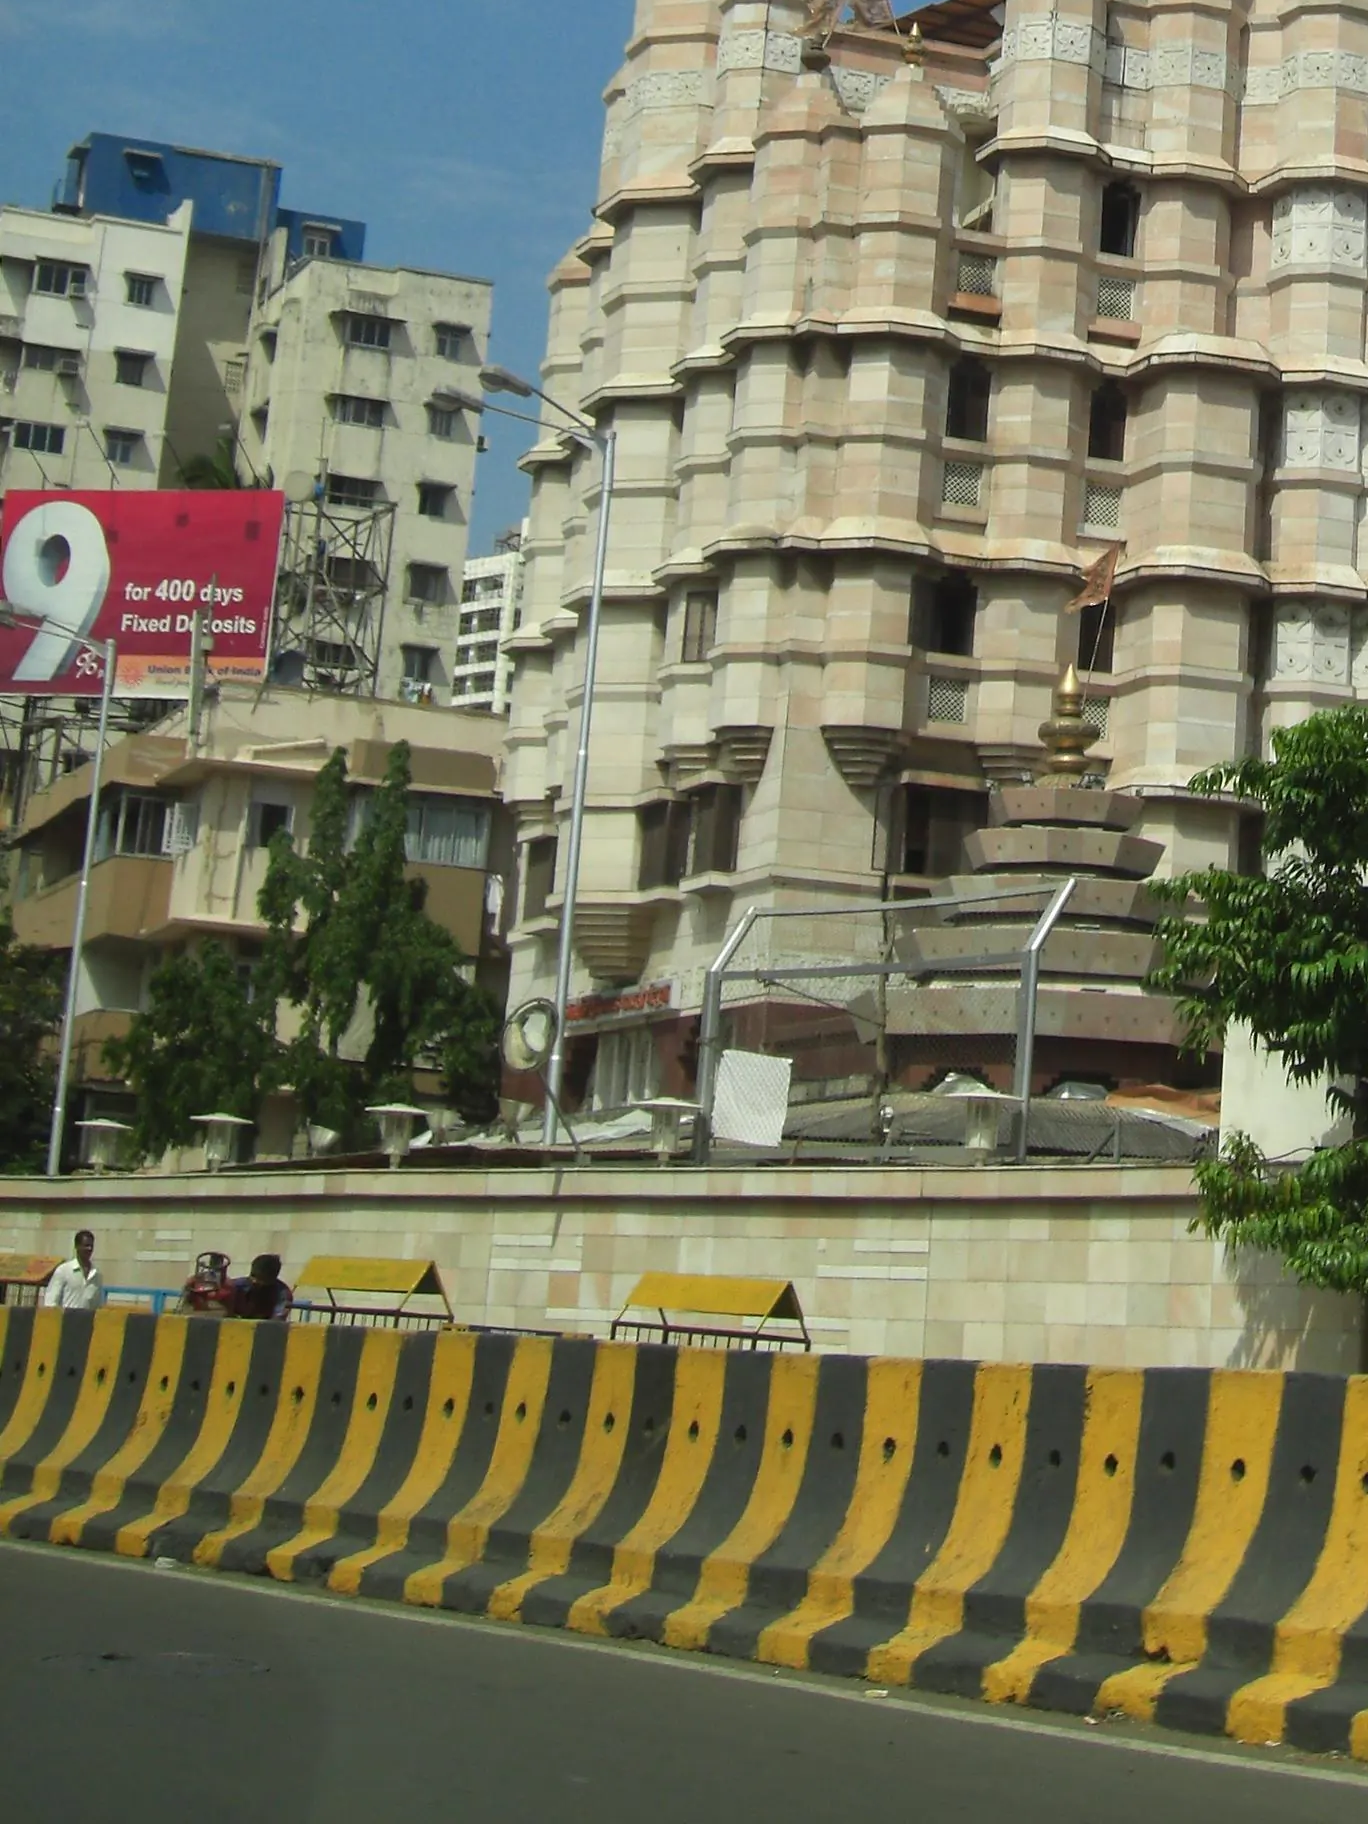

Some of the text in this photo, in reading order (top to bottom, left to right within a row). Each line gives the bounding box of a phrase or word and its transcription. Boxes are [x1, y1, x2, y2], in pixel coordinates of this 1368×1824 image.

[3, 501, 110, 680] 9
[124, 579, 244, 606] for 400 days
[120, 614, 171, 633] Fixed
[147, 665, 181, 675] Union
